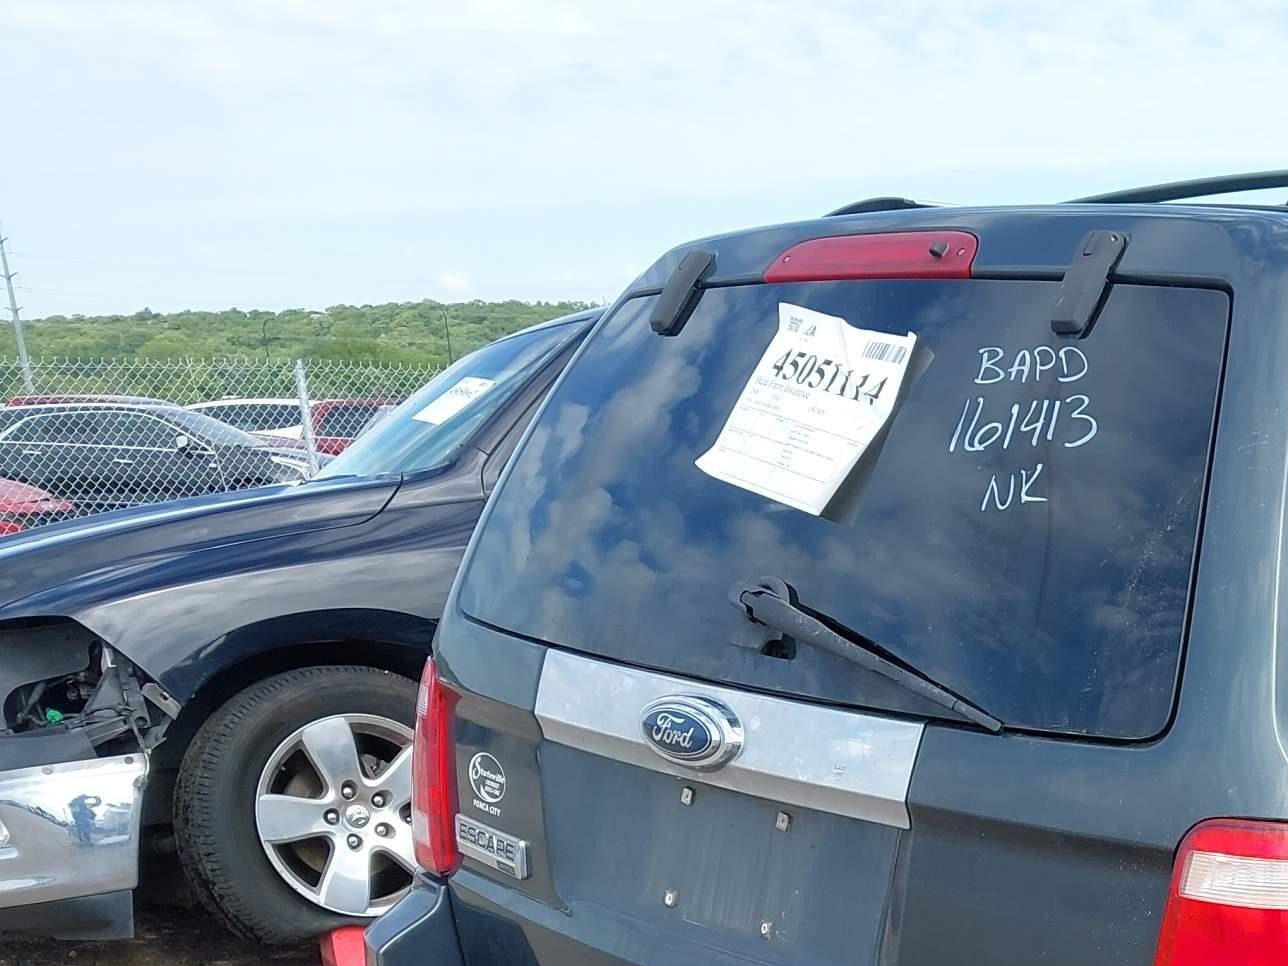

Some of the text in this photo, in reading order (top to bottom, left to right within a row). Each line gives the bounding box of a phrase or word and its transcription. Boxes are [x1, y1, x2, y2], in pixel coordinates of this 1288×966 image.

[773, 349, 889, 405] 45051114
[974, 346, 1088, 384] BAPD
[949, 395, 1098, 452] 161413
[981, 463, 1048, 511] NK
[652, 713, 694, 748] Ford
[473, 799, 501, 817] PONCA CITY
[459, 822, 515, 861] ESCAPE
